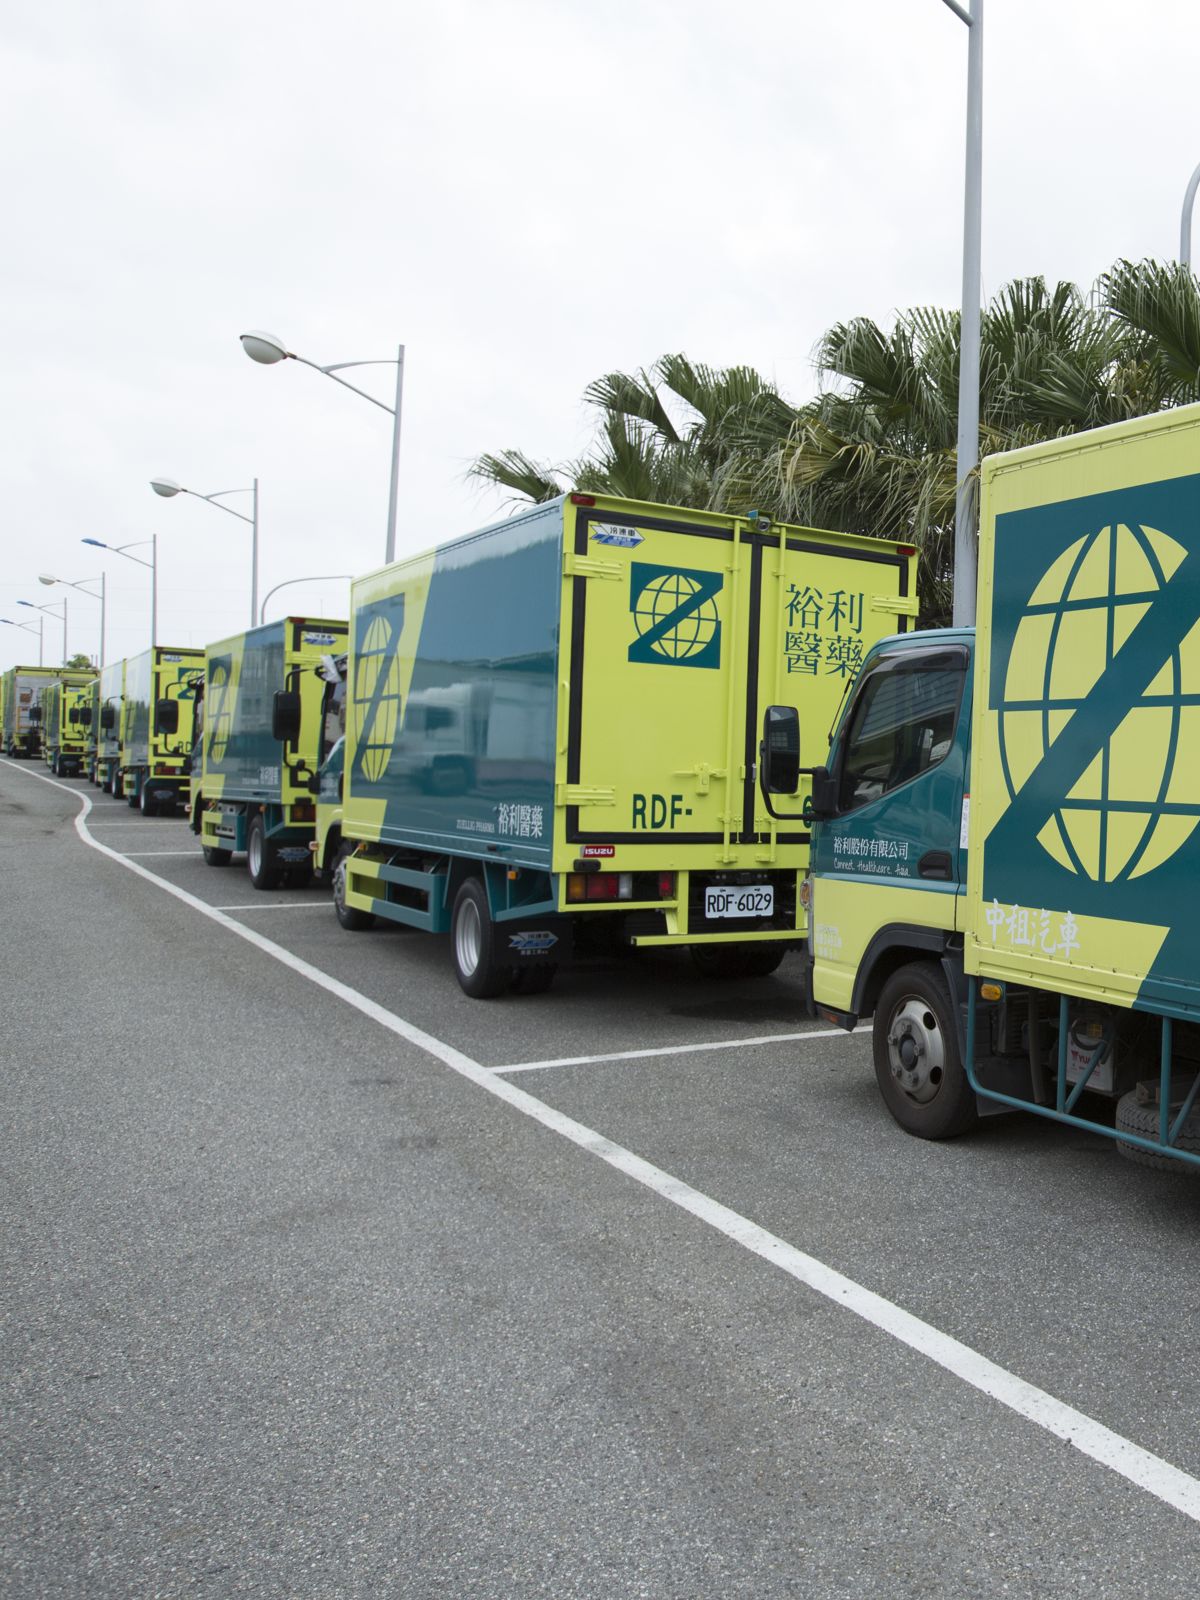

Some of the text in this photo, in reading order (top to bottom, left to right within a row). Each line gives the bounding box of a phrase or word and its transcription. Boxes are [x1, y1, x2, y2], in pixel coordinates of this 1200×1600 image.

[785, 583, 864, 634] 裕利
[784, 631, 863, 678] 醫藥
[498, 802, 543, 839] 裕利醫藥
[833, 836, 909, 860] 裕利股份有限公司
[707, 893, 772, 913] RDF-6029
[985, 898, 1081, 960] 中租汽車
